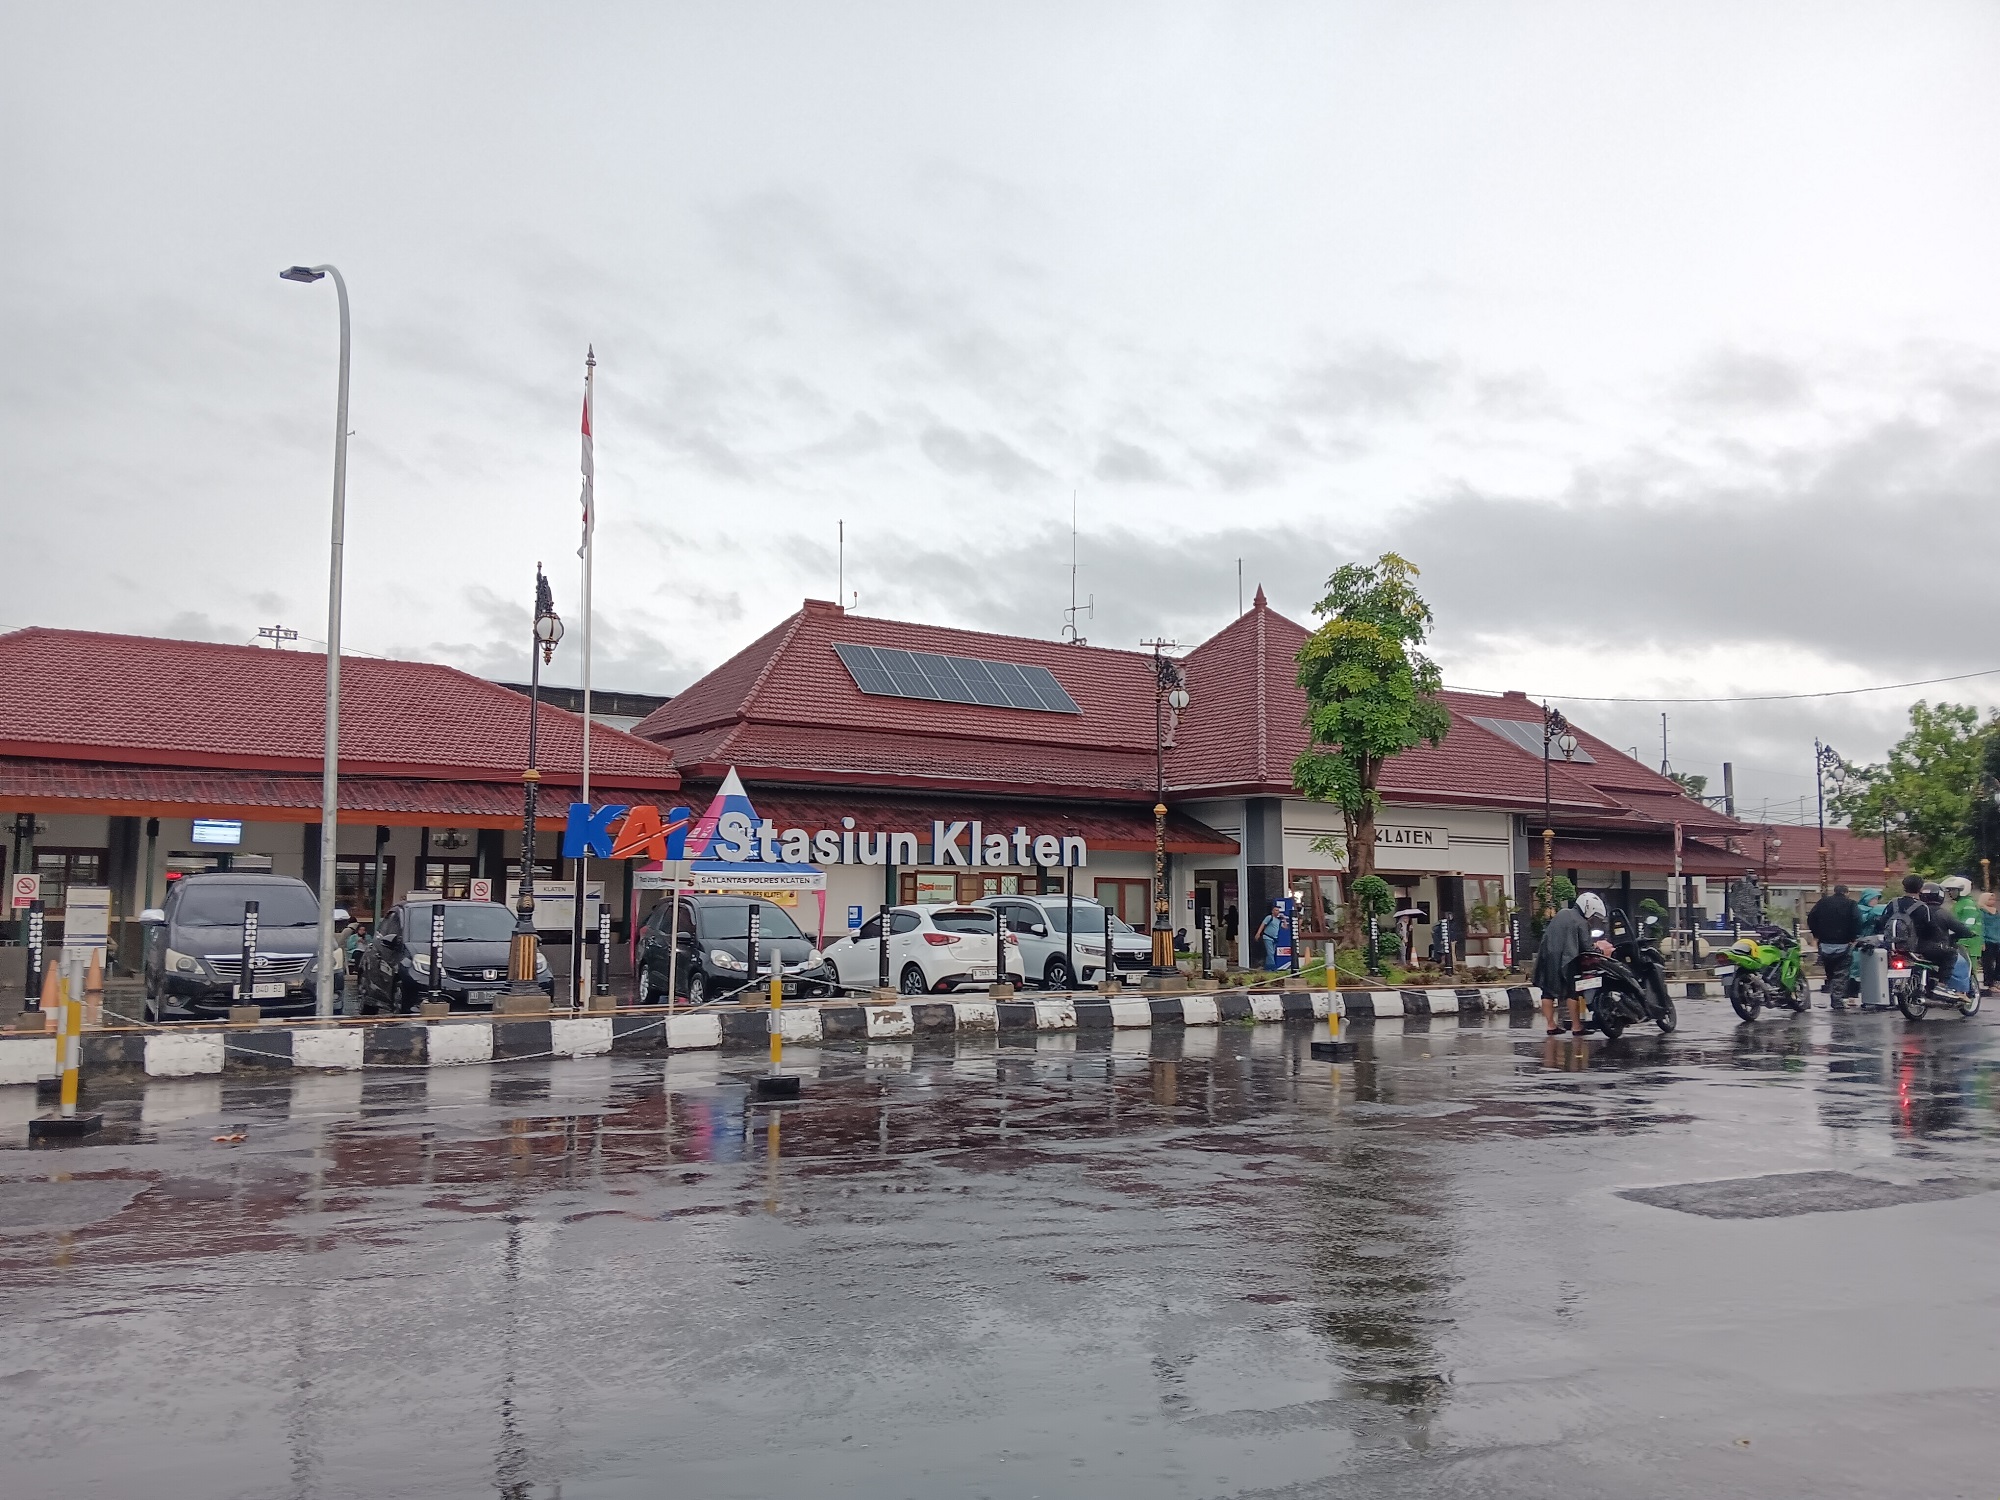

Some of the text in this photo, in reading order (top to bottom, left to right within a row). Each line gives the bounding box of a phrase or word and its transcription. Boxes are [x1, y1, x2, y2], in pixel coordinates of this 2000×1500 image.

[563, 803, 691, 861] KAI
[715, 811, 919, 866] Stasiun
[932, 820, 1088, 868] Klaten
[1374, 828, 1433, 845] KLATEN
[701, 876, 747, 884] SATLANTAS
